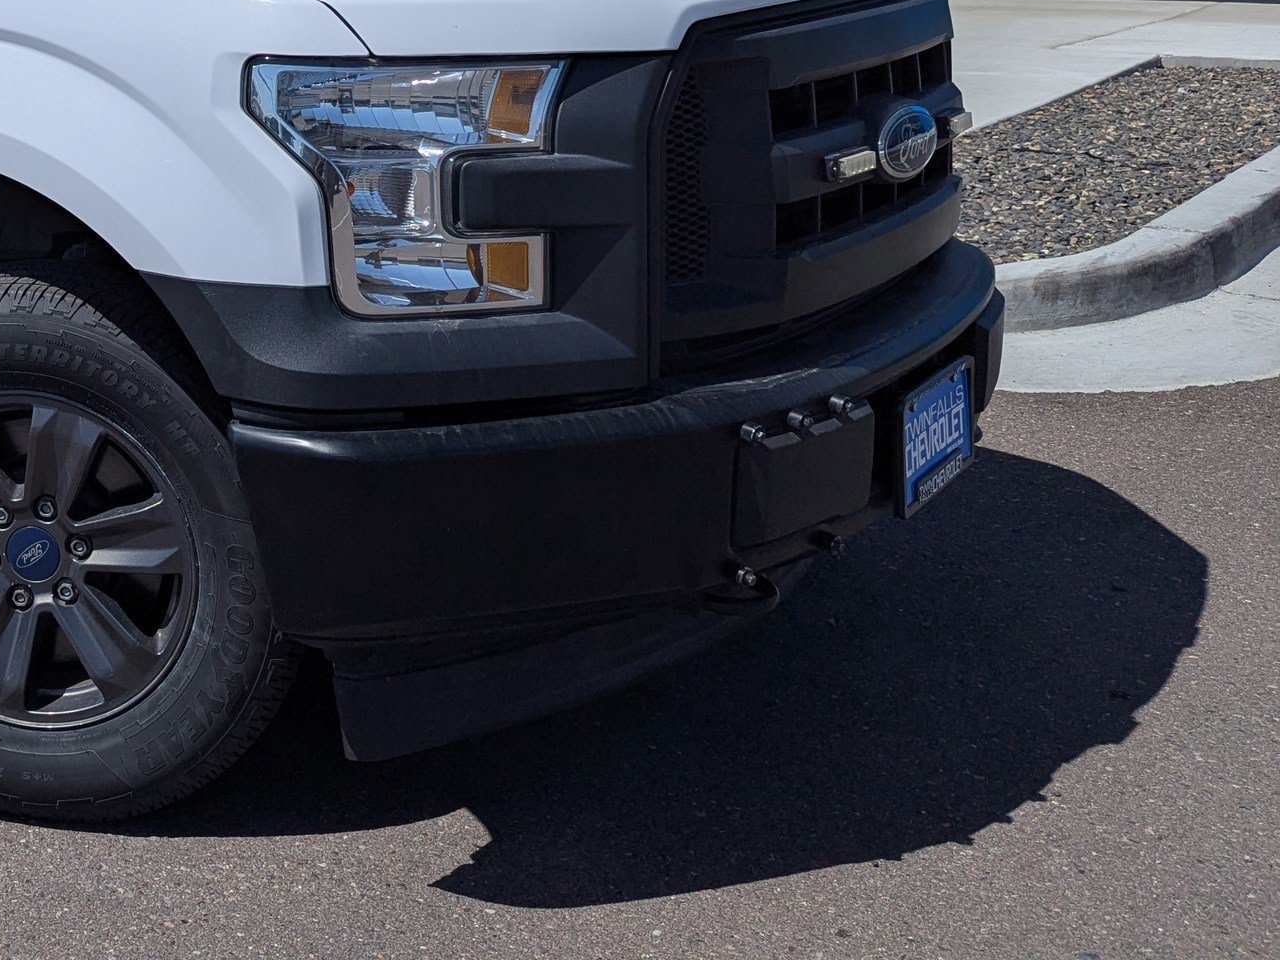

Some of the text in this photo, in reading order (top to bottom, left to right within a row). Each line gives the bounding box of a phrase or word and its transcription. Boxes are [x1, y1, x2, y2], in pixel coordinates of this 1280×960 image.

[904, 384, 965, 444] TWINFALLS
[904, 402, 965, 479] CHEVROLET
[134, 543, 257, 777] GOODYEAR
